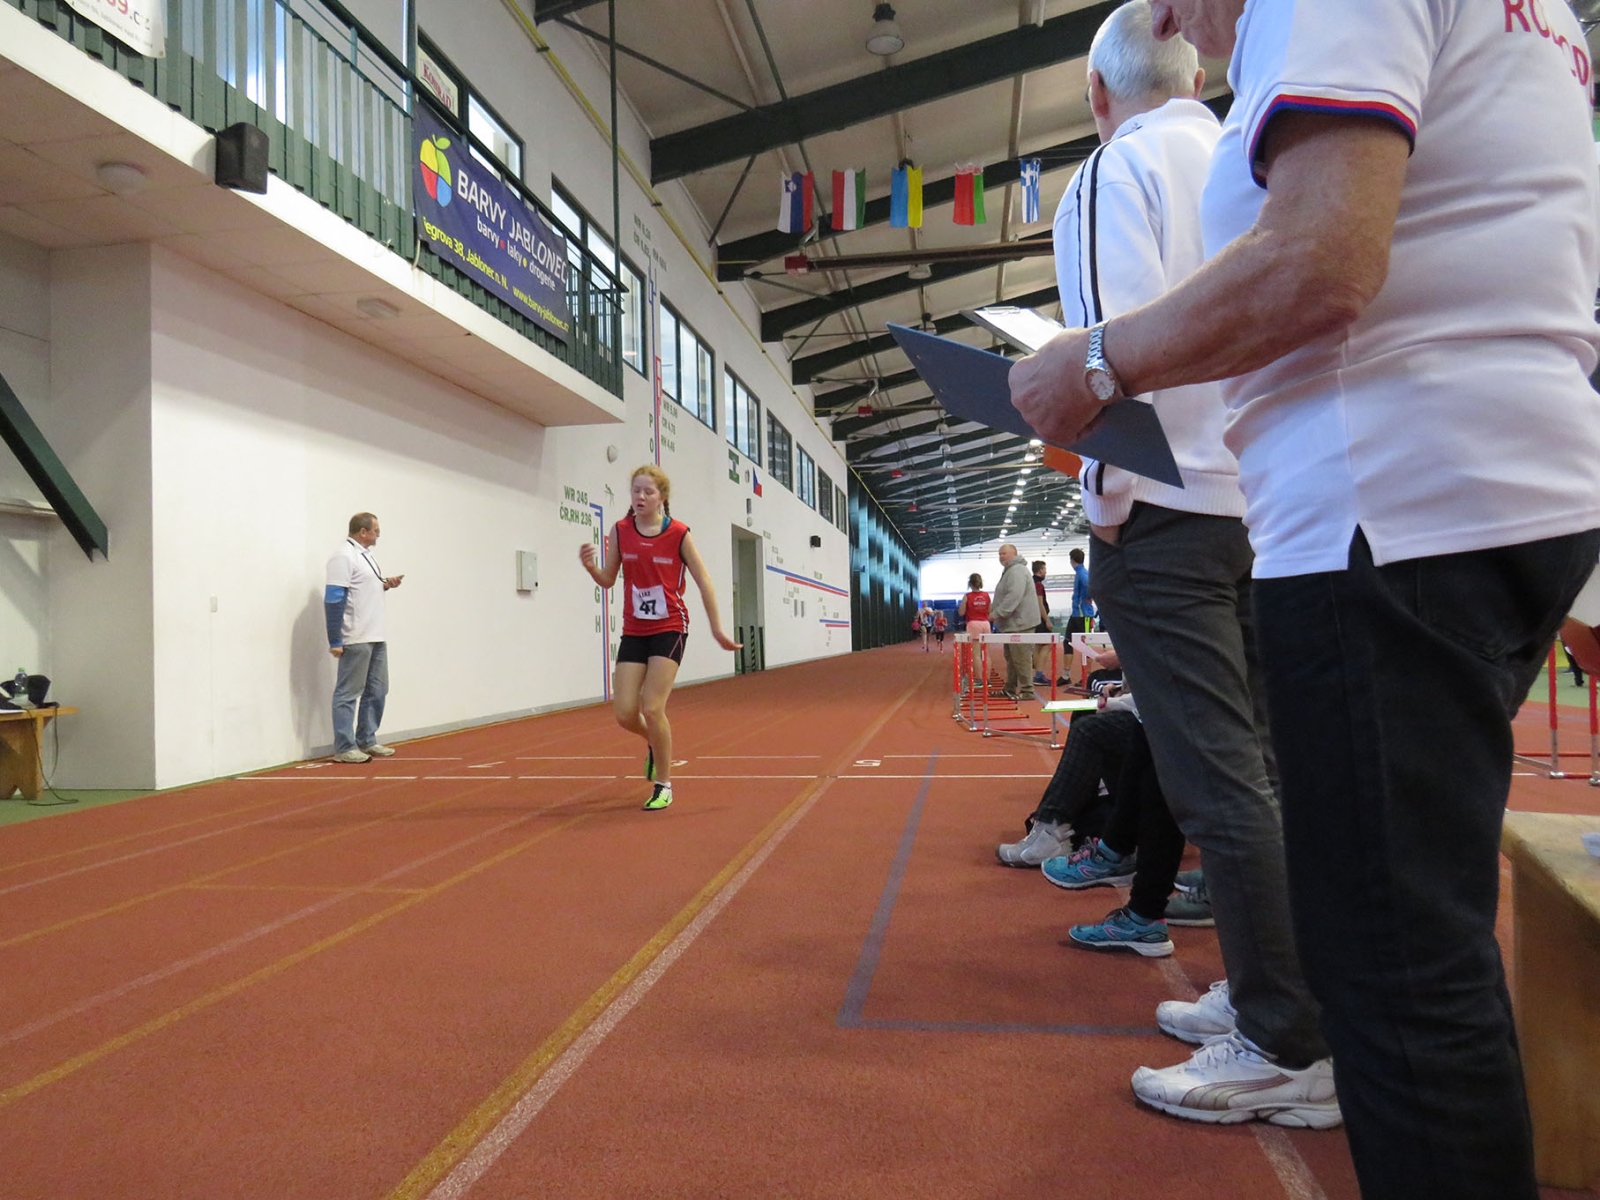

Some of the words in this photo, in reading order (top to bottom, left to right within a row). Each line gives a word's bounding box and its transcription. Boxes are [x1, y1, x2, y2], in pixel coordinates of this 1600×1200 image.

[457, 169, 507, 230] BARVY
[508, 216, 568, 284] JABLONEC
[453, 237, 466, 261] 38,
[466, 248, 495, 280] Jablonec
[477, 214, 500, 249] barvy
[507, 239, 523, 267] laky
[529, 260, 556, 291] drogerie
[563, 484, 576, 502] WR
[576, 489, 588, 506] 245
[639, 599, 656, 615] 47
